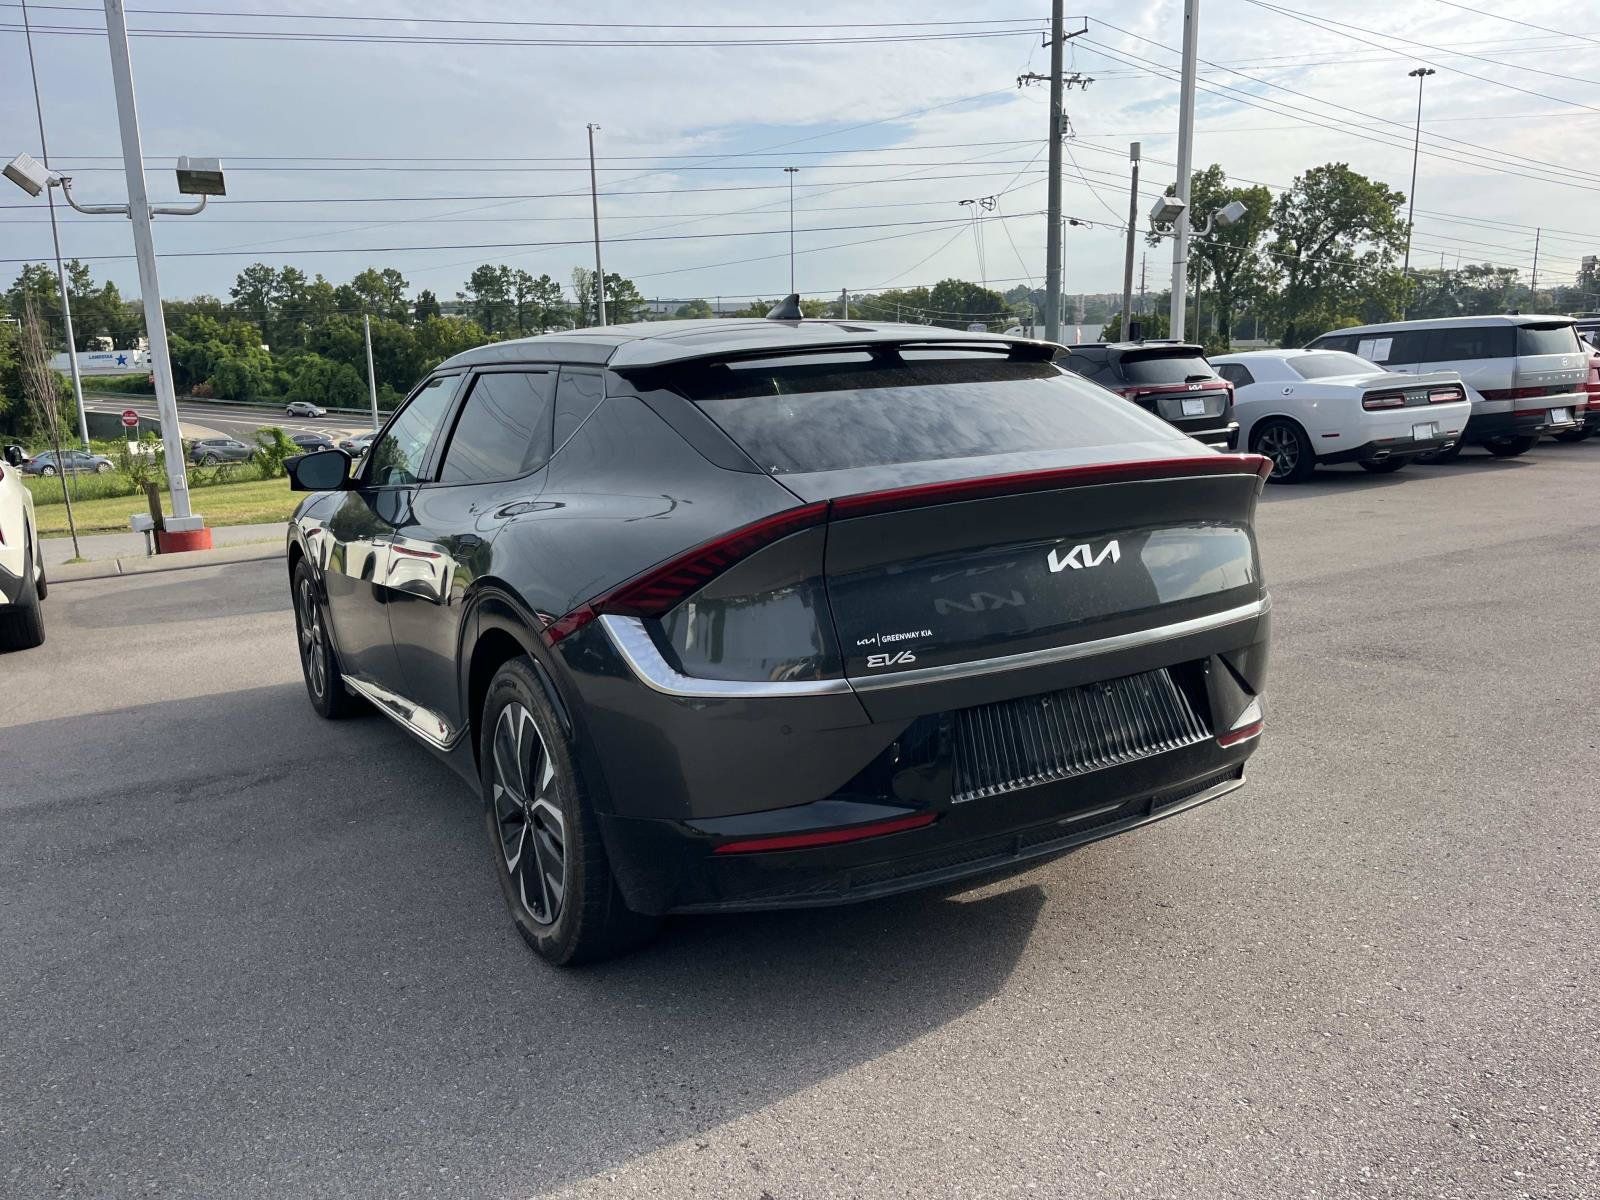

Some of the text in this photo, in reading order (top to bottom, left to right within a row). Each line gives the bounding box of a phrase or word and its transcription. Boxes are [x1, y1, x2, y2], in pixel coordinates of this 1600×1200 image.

[1047, 540, 1121, 573] KIA
[881, 631, 920, 643] GREENWAY
[920, 629, 933, 638] KIA
[867, 650, 917, 668] EV6
